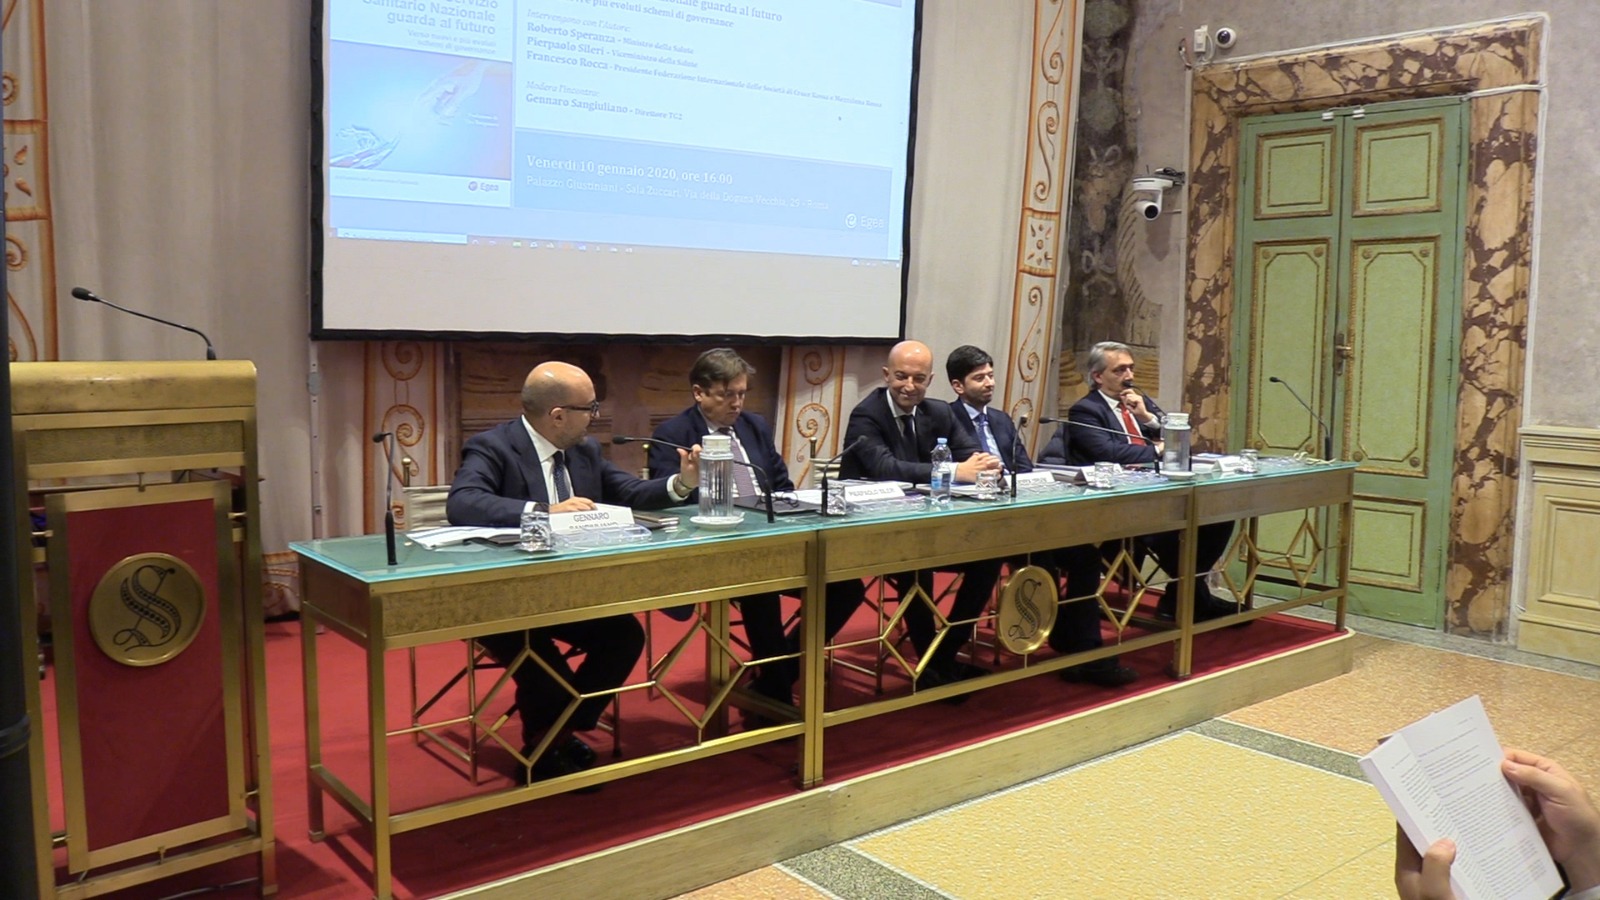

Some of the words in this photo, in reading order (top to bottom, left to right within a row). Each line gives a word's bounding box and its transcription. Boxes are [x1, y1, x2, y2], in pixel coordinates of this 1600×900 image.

[430, 3, 495, 22] Nazionale
[609, 1, 641, 12] evoluti
[643, 6, 675, 18] schemi
[676, 10, 685, 20] di
[686, 13, 735, 28] governance
[700, 0, 737, 14] guarda
[739, 6, 749, 17] al
[751, 7, 783, 22] futuro
[387, 11, 436, 27] guarda
[440, 17, 452, 29] al
[455, 19, 496, 35] futuro
[527, 22, 569, 36] Roberto
[570, 29, 616, 43] Speranza
[582, 19, 598, 28] con
[526, 36, 577, 52] Pierpaolo
[578, 43, 604, 56] Sileri
[526, 50, 578, 65] Francesco
[580, 58, 609, 70] Rocca
[526, 80, 557, 92] Modera
[526, 93, 569, 107] Gennaro
[570, 98, 628, 114] Sangiuliano
[580, 160, 595, 173] 10
[597, 163, 645, 178] gennaio
[646, 166, 679, 181] 2020,
[681, 172, 700, 182] ore
[702, 172, 733, 185] 16.00
[480, 182, 499, 193] Egea
[527, 175, 563, 188] Palazzo
[566, 178, 618, 193] Giustiniani
[625, 183, 645, 196] Sala
[684, 188, 698, 200] Via
[860, 216, 885, 229] Egea
[573, 512, 609, 522] GENNARO
